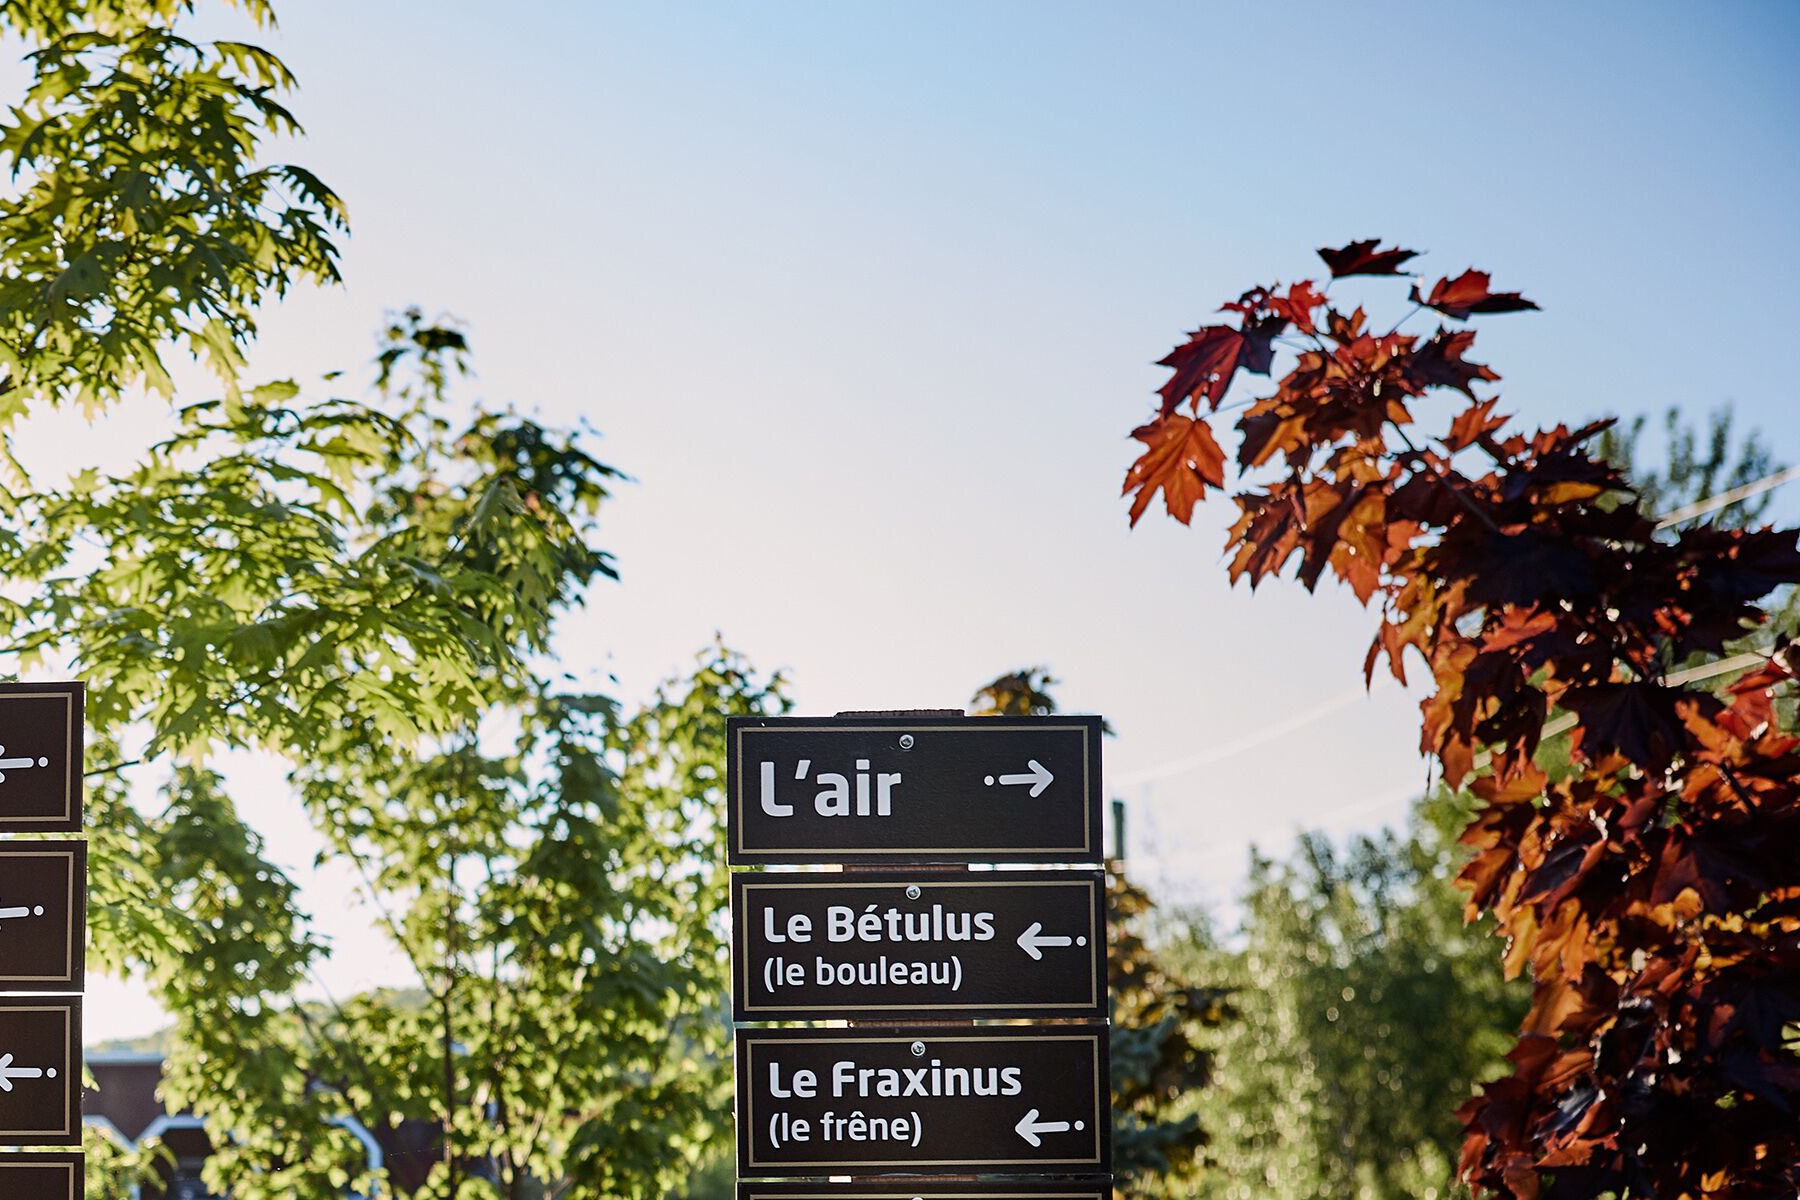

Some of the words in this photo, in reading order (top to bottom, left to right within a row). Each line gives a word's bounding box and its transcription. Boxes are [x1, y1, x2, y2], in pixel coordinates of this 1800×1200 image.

[760, 759, 902, 817] L'air
[764, 906, 812, 943] Le
[827, 904, 995, 943] Bétulus
[764, 956, 805, 993] (le
[816, 955, 962, 991] bouleau)
[769, 1062, 818, 1098] Le
[832, 1059, 1022, 1098] Fraxinus
[769, 1112, 810, 1149] (le
[819, 1110, 922, 1147] frêne)
